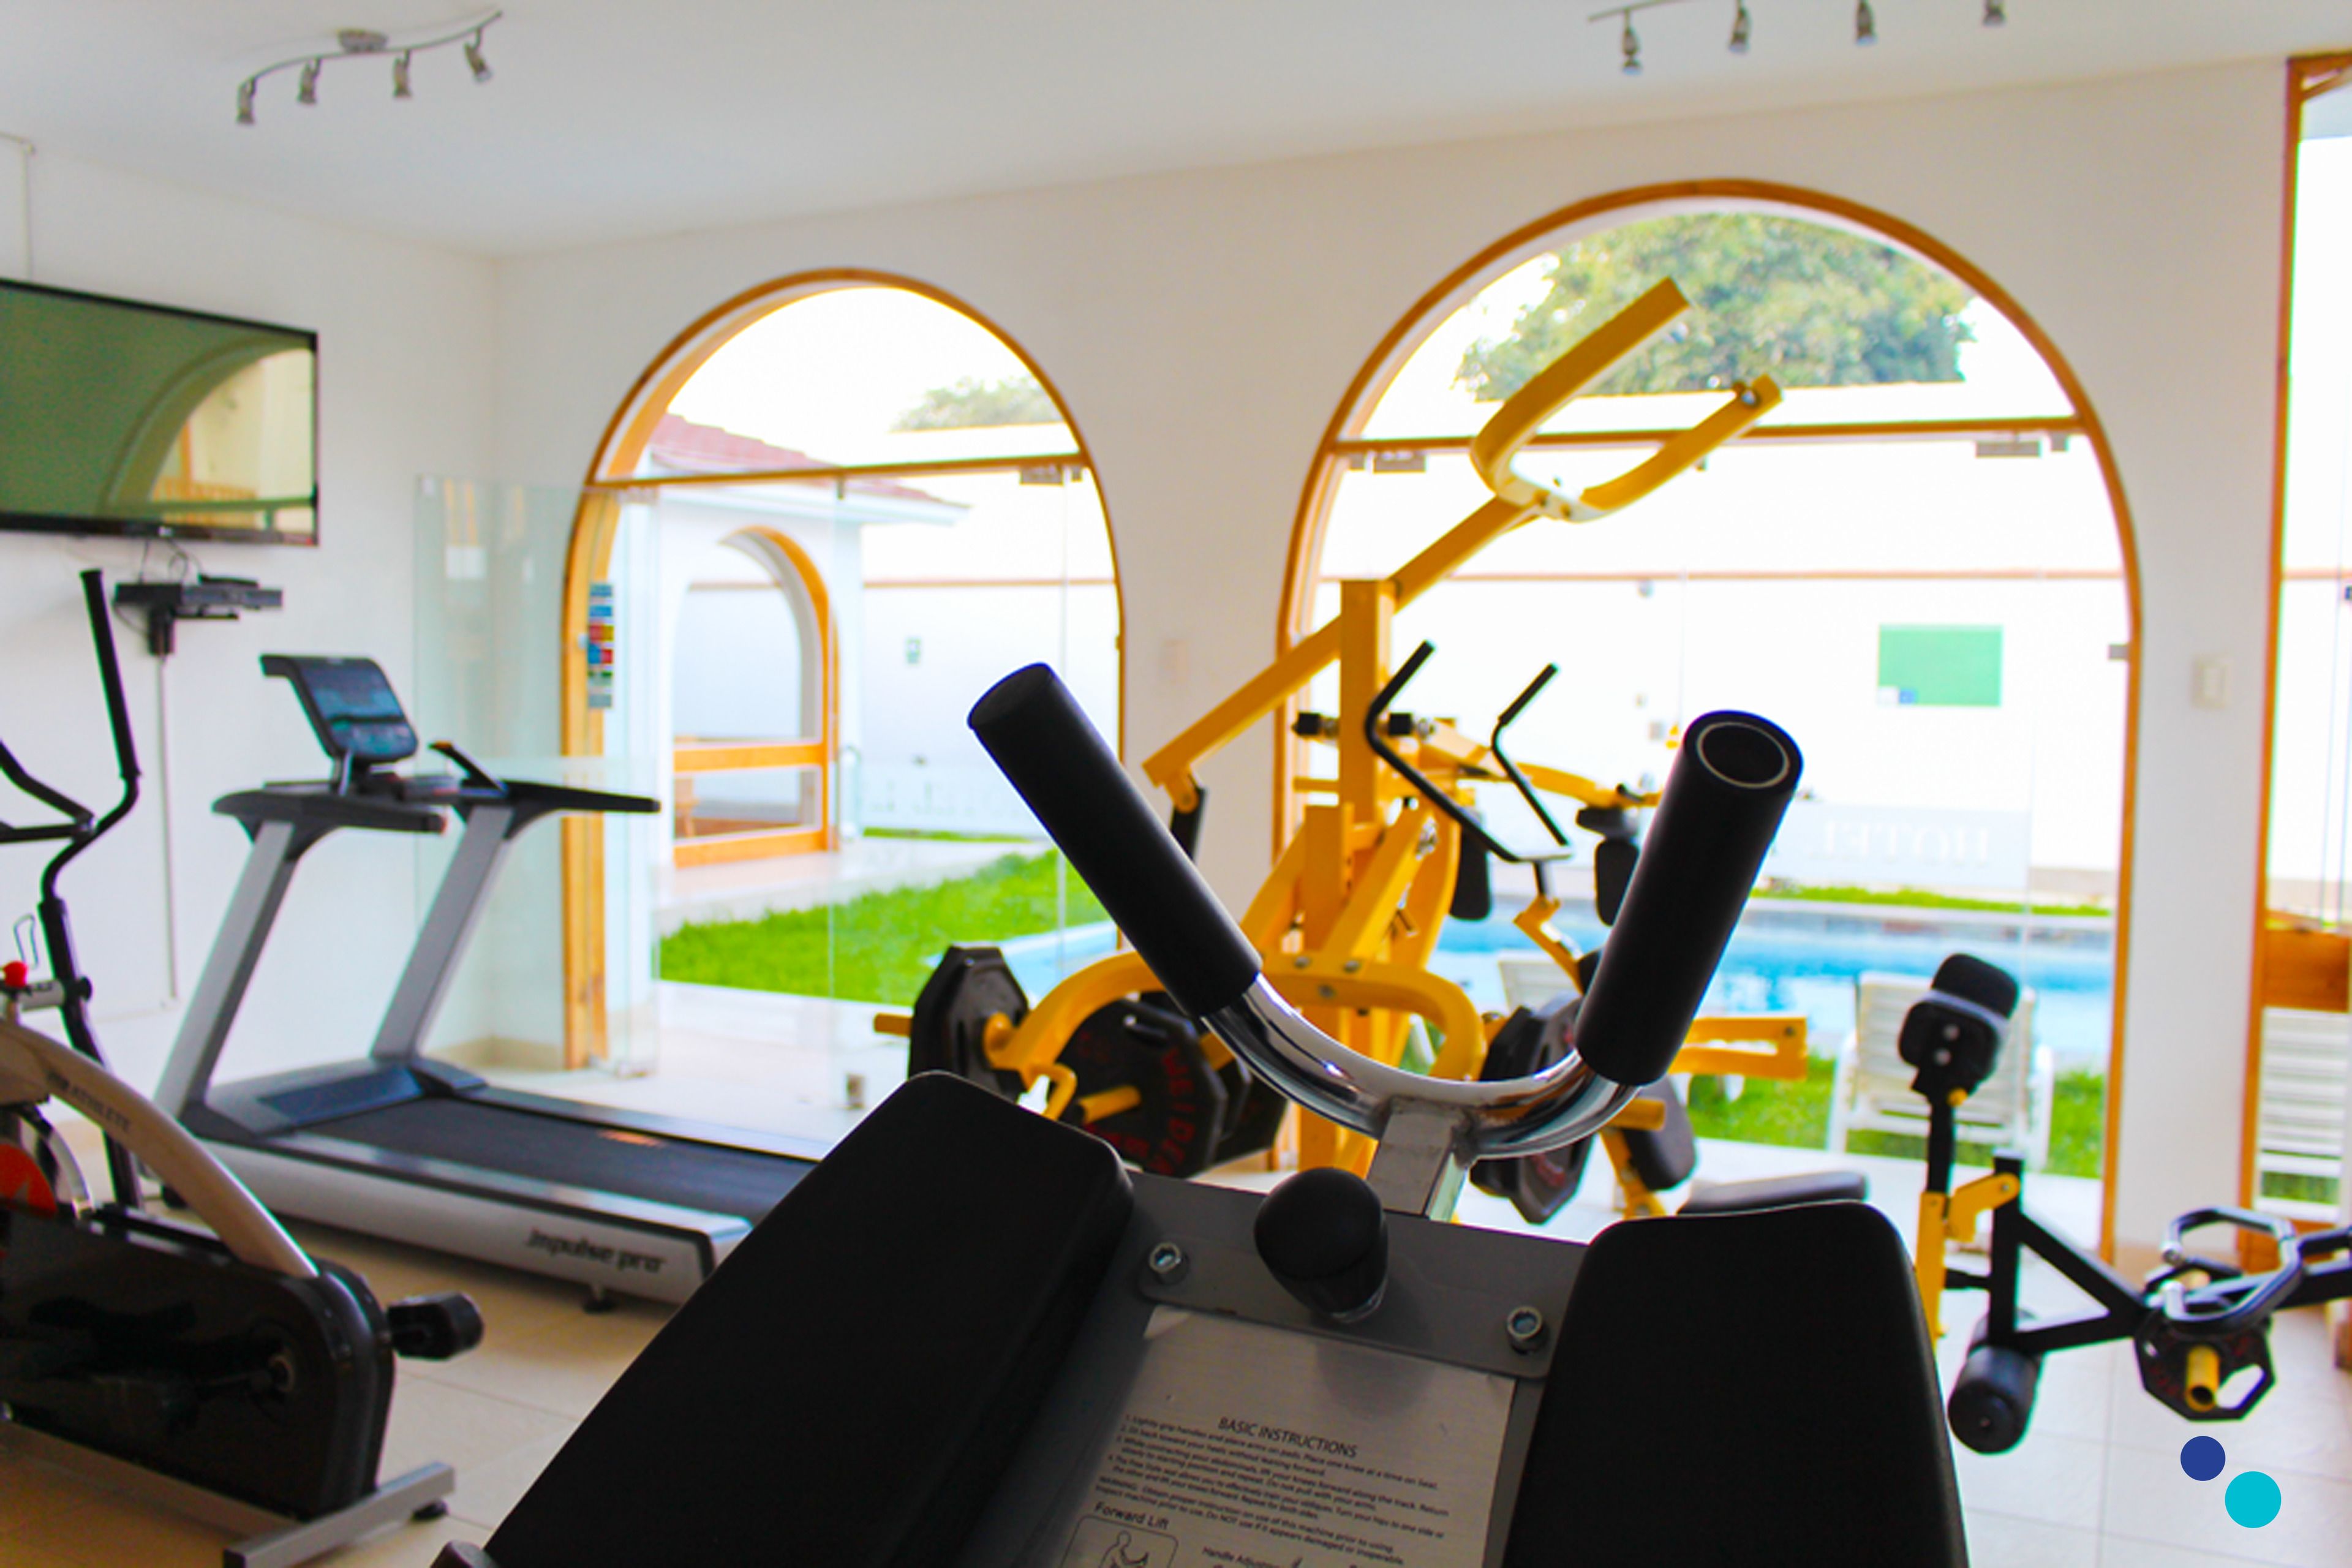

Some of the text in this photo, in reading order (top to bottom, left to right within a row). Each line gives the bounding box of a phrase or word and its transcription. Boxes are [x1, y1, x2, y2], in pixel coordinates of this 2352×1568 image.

[1218, 1417, 1357, 1457] BASIC INSTRUCTIONS
[1095, 1501, 1170, 1529] Forward Lift
[1202, 1546, 1234, 1562] Handle
